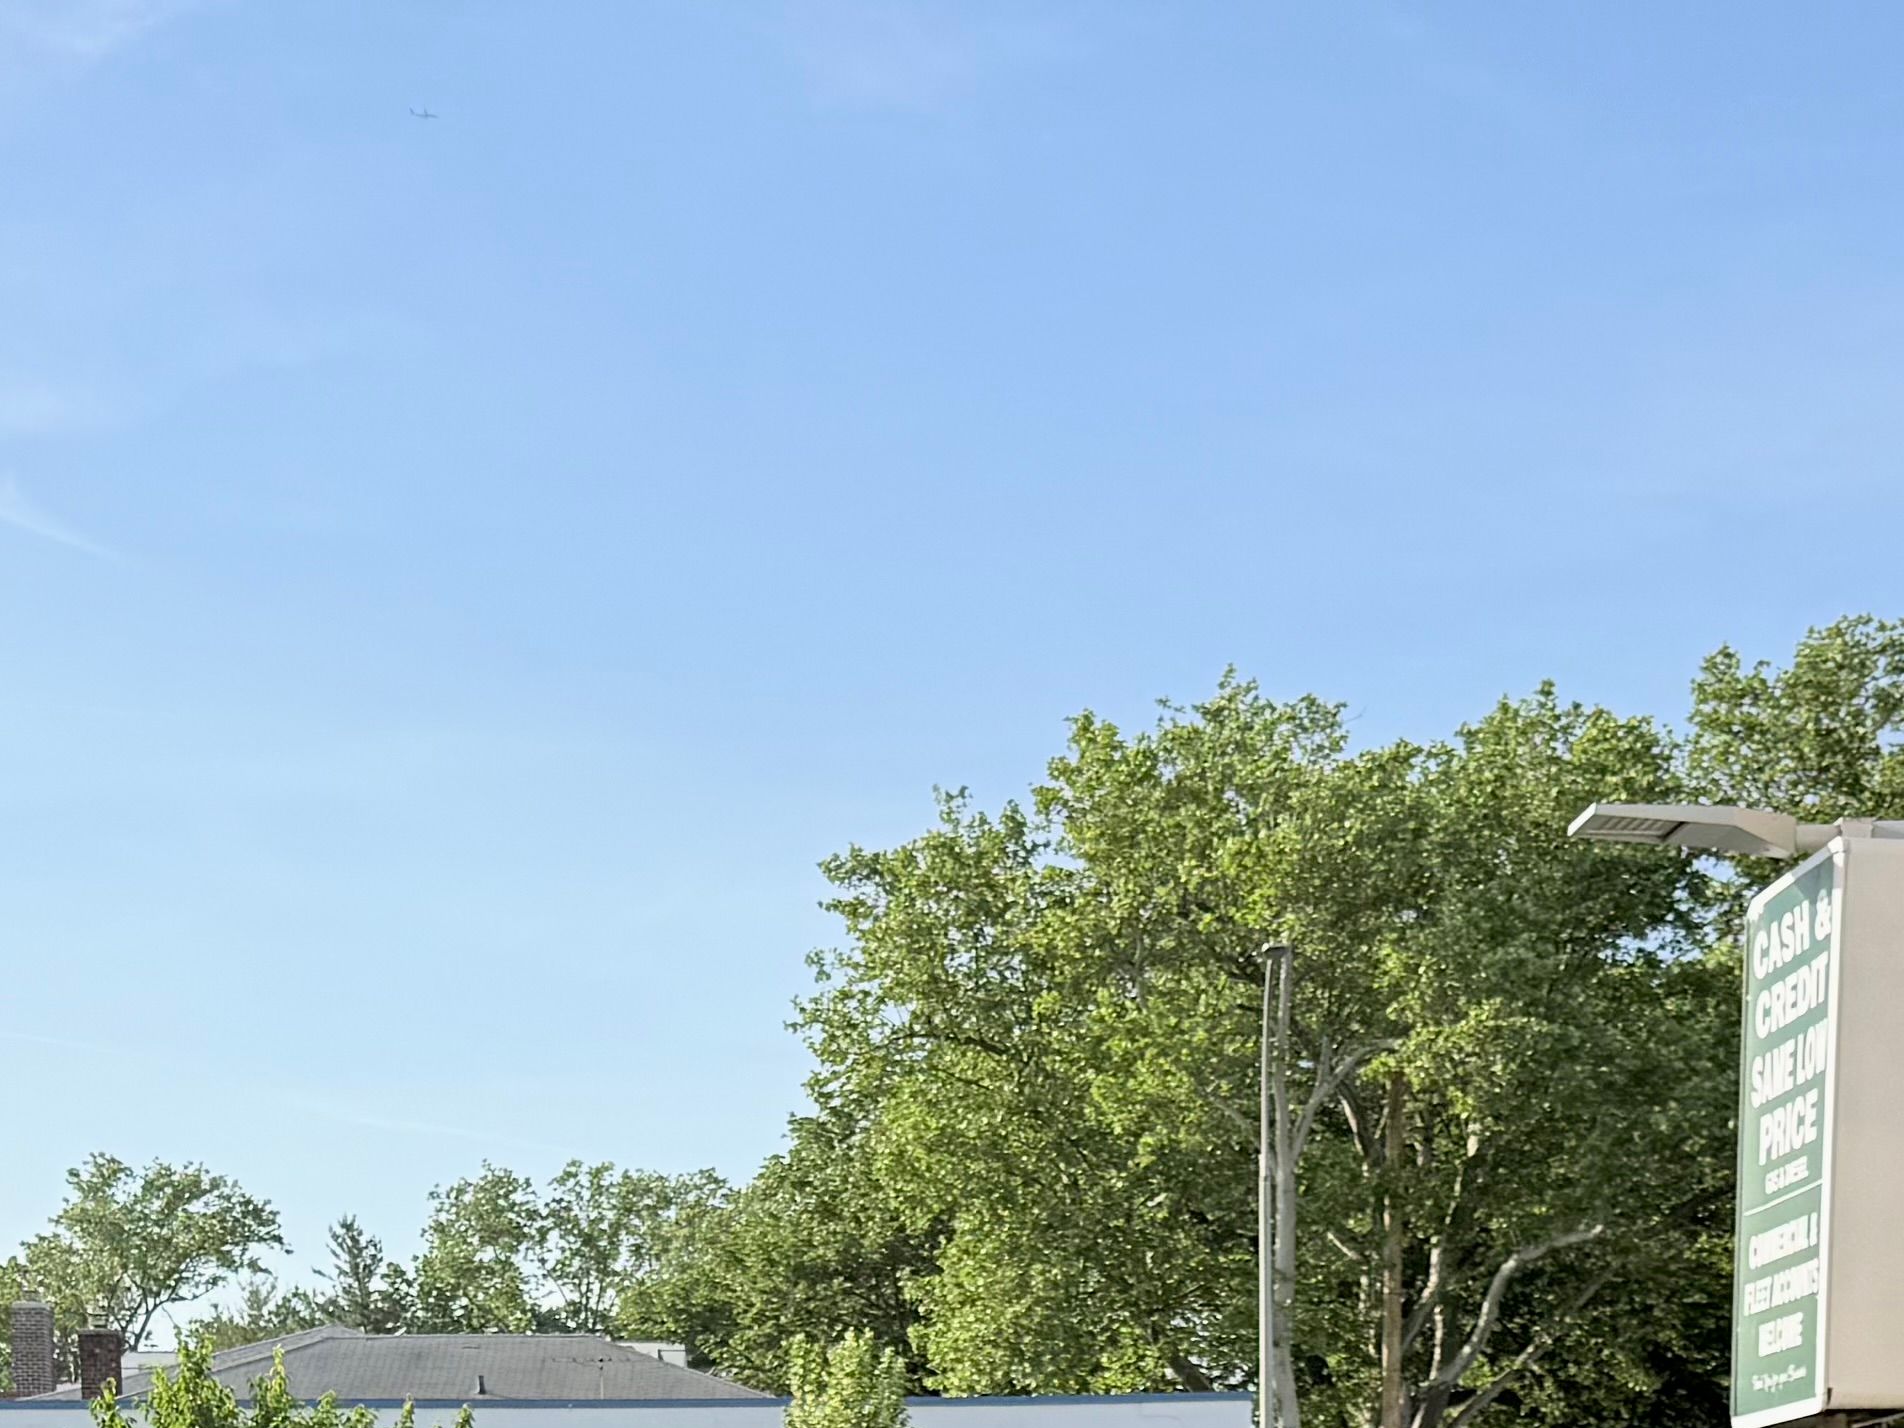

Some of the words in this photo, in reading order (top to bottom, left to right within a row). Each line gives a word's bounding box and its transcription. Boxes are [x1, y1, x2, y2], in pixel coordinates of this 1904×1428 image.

[1753, 899, 1810, 980] CASH
[1815, 888, 1832, 942] &
[1755, 951, 1830, 1040] CREDIT
[1750, 1037, 1796, 1110] SAME
[1796, 1017, 1829, 1086] LOW
[1758, 1087, 1819, 1166] PRICE
